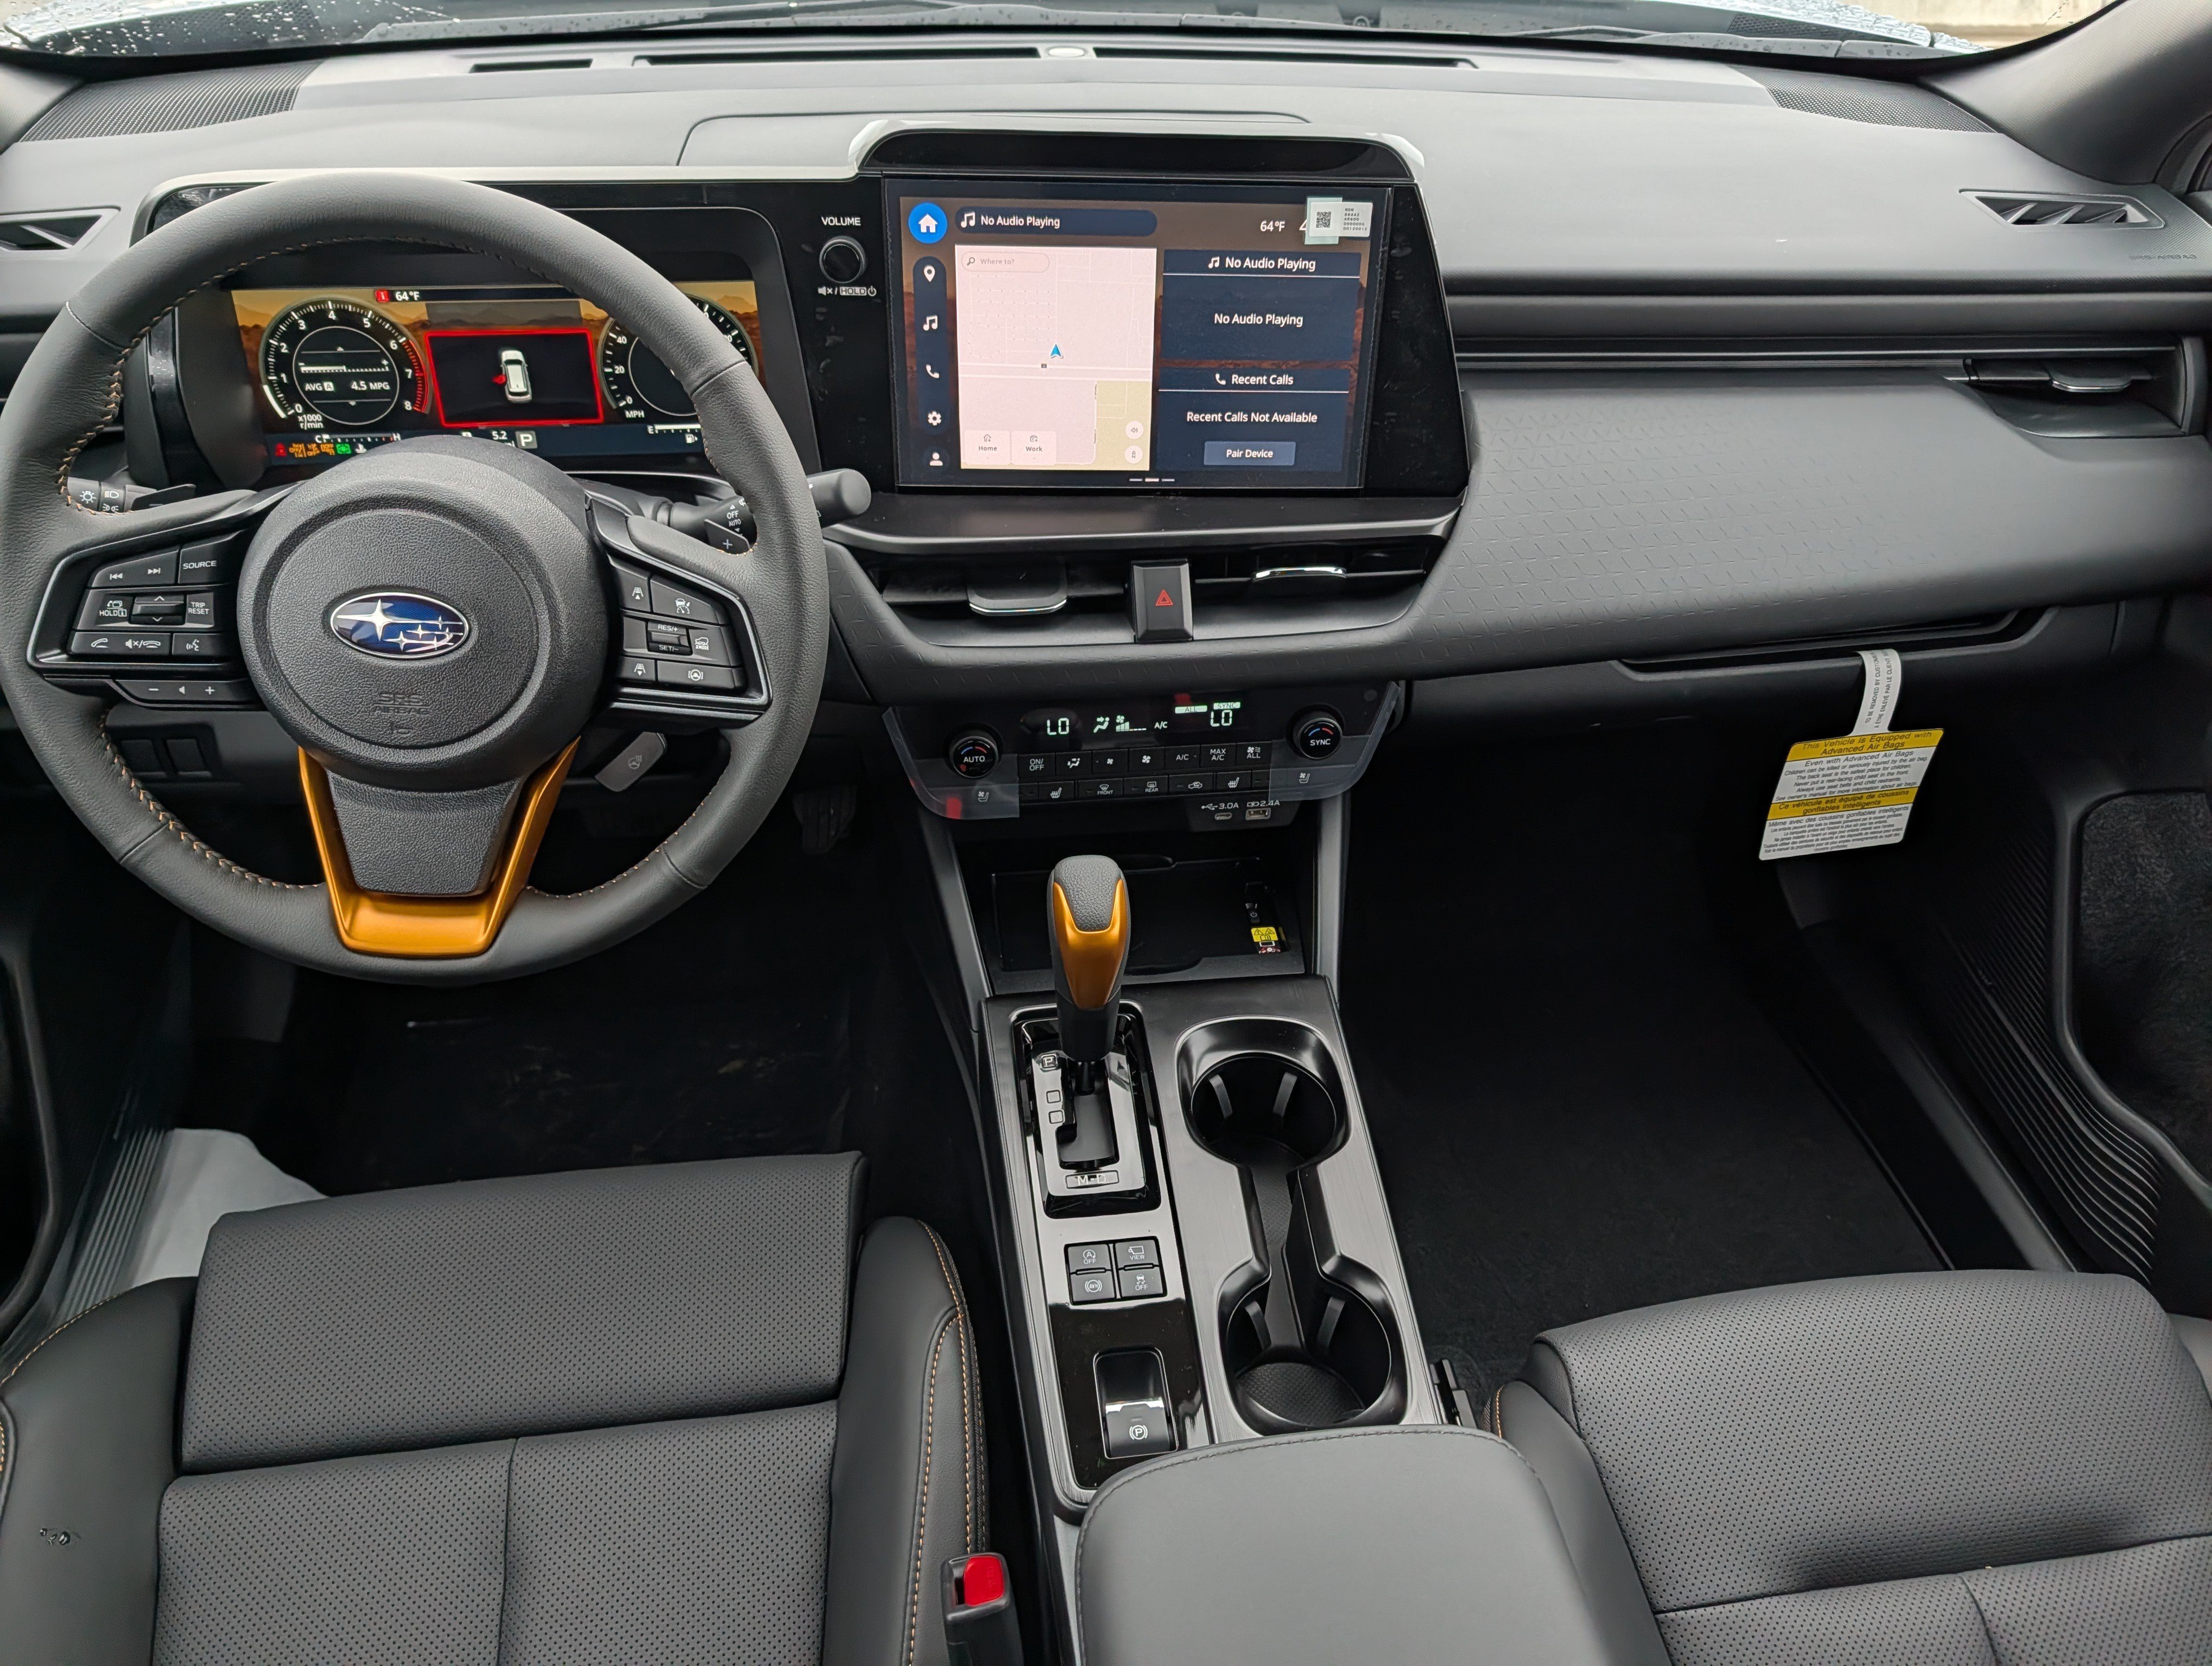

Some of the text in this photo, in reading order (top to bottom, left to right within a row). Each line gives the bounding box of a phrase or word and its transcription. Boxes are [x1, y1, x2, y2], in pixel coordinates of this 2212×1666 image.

[821, 216, 861, 226] VOLUME
[980, 216, 1060, 229] No Audio Playing
[1225, 258, 1316, 272] No Audio Playing
[841, 287, 865, 296] HOLD
[328, 310, 336, 321] 4
[1214, 313, 1303, 327] No Audio Playing
[298, 320, 306, 330] 3
[363, 318, 371, 328] 5
[616, 336, 627, 344] 40
[280, 343, 288, 353] 2
[390, 340, 397, 350] 6
[405, 369, 412, 378] 7
[615, 366, 625, 374] 20
[281, 374, 286, 382] 1
[1232, 375, 1294, 385] Recent Calls
[305, 381, 390, 392] AVG 4.5 MPG
[625, 396, 633, 405] 0
[295, 403, 302, 413] 0
[404, 400, 412, 411] 8
[298, 414, 321, 422] x1000
[625, 409, 645, 419] MPH
[1187, 412, 1317, 423] Recent Calls Not Available
[300, 420, 323, 429] r/min
[648, 425, 654, 434] E
[393, 433, 401, 441] H
[491, 431, 507, 440] 5.2
[520, 433, 532, 447] P
[1226, 449, 1274, 458] Pair Device
[727, 510, 739, 518] OFF
[729, 519, 742, 527] AUTO
[183, 560, 217, 569] SOURCE
[1870, 688, 1879, 709] REMOVED
[1154, 721, 1168, 729] A/C
[1824, 738, 1855, 747] Vehicle
[1869, 733, 1912, 742] Equipped
[1821, 745, 1864, 755] Advanced
[1882, 741, 1905, 749] Bags
[963, 755, 985, 764] AUTO
[1843, 753, 1880, 762] Advanced
[1792, 799, 1823, 808] véhicule
[1803, 800, 1881, 815] gonflables intelligents
[1846, 810, 1876, 819] gonflables
[1044, 1058, 1054, 1066] P
